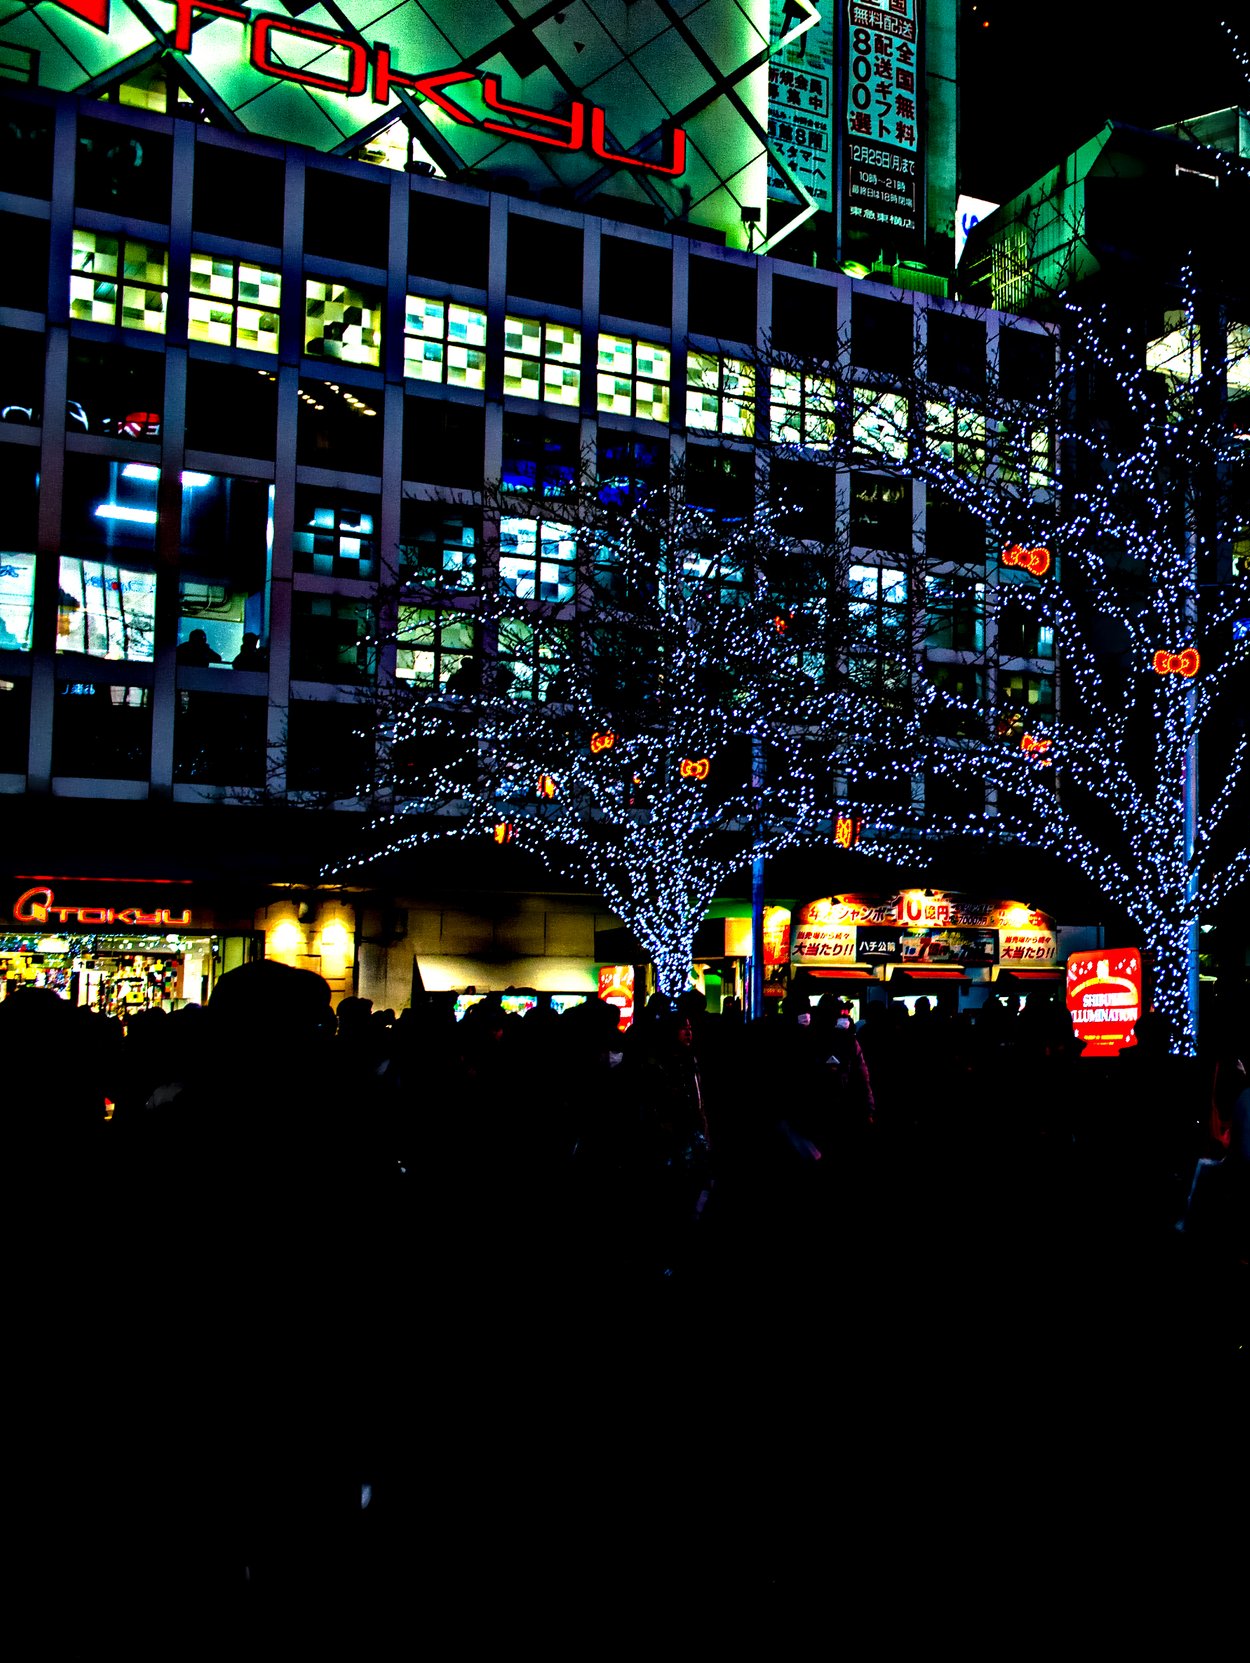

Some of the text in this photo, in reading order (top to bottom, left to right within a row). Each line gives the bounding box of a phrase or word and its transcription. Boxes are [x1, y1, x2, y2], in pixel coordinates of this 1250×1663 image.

[853, 6, 914, 40] 無料配送
[173, 0, 687, 176] TOKYU
[873, 33, 894, 139] 配送ギフト
[895, 41, 915, 147] 全国無料
